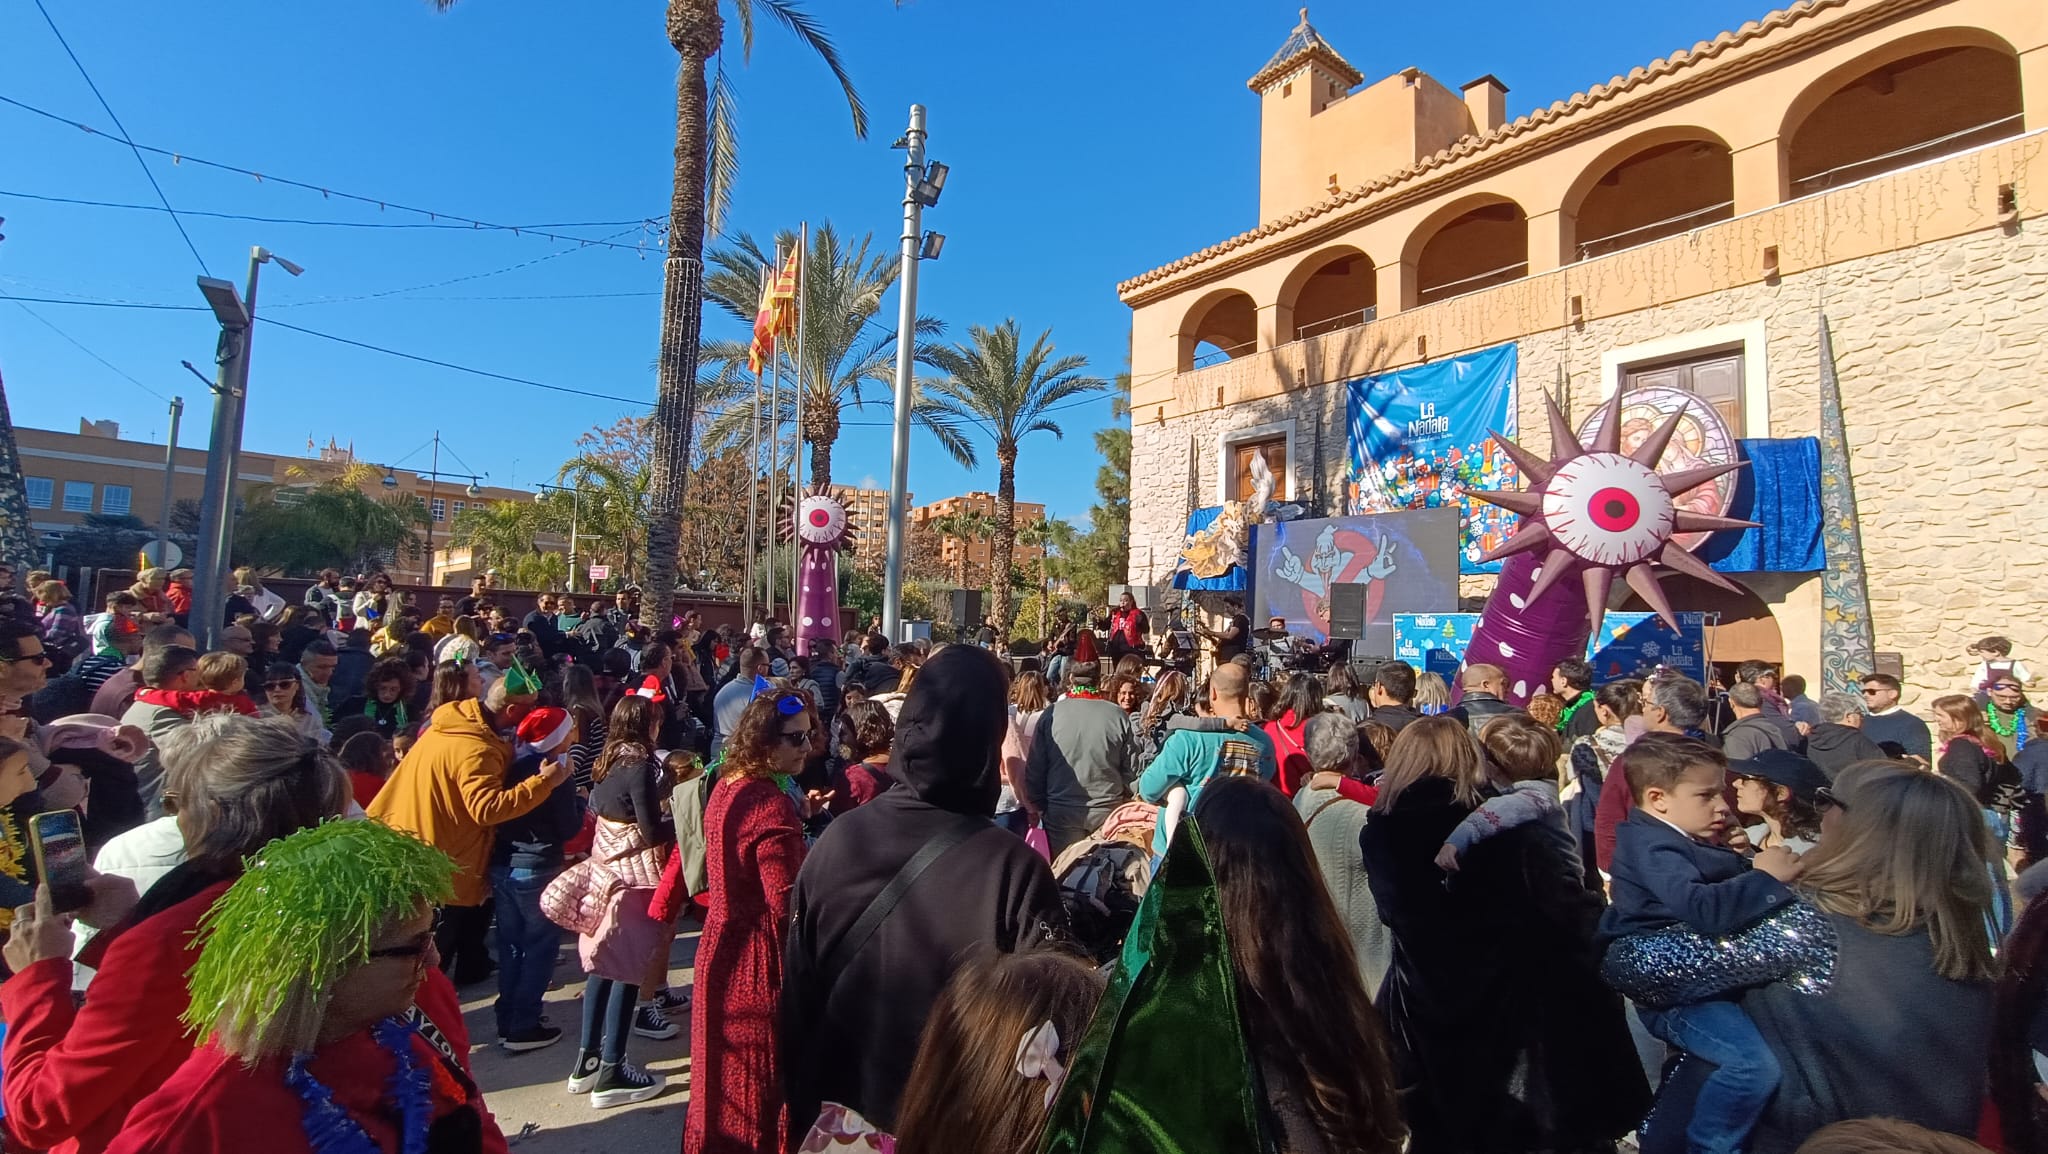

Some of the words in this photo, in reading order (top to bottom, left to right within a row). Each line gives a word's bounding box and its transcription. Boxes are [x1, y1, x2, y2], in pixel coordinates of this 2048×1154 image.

[1420, 402, 1434, 419] La
[1408, 415, 1449, 438] Nadala
[1672, 645, 1683, 655] La
[1662, 654, 1693, 666] Nadala
